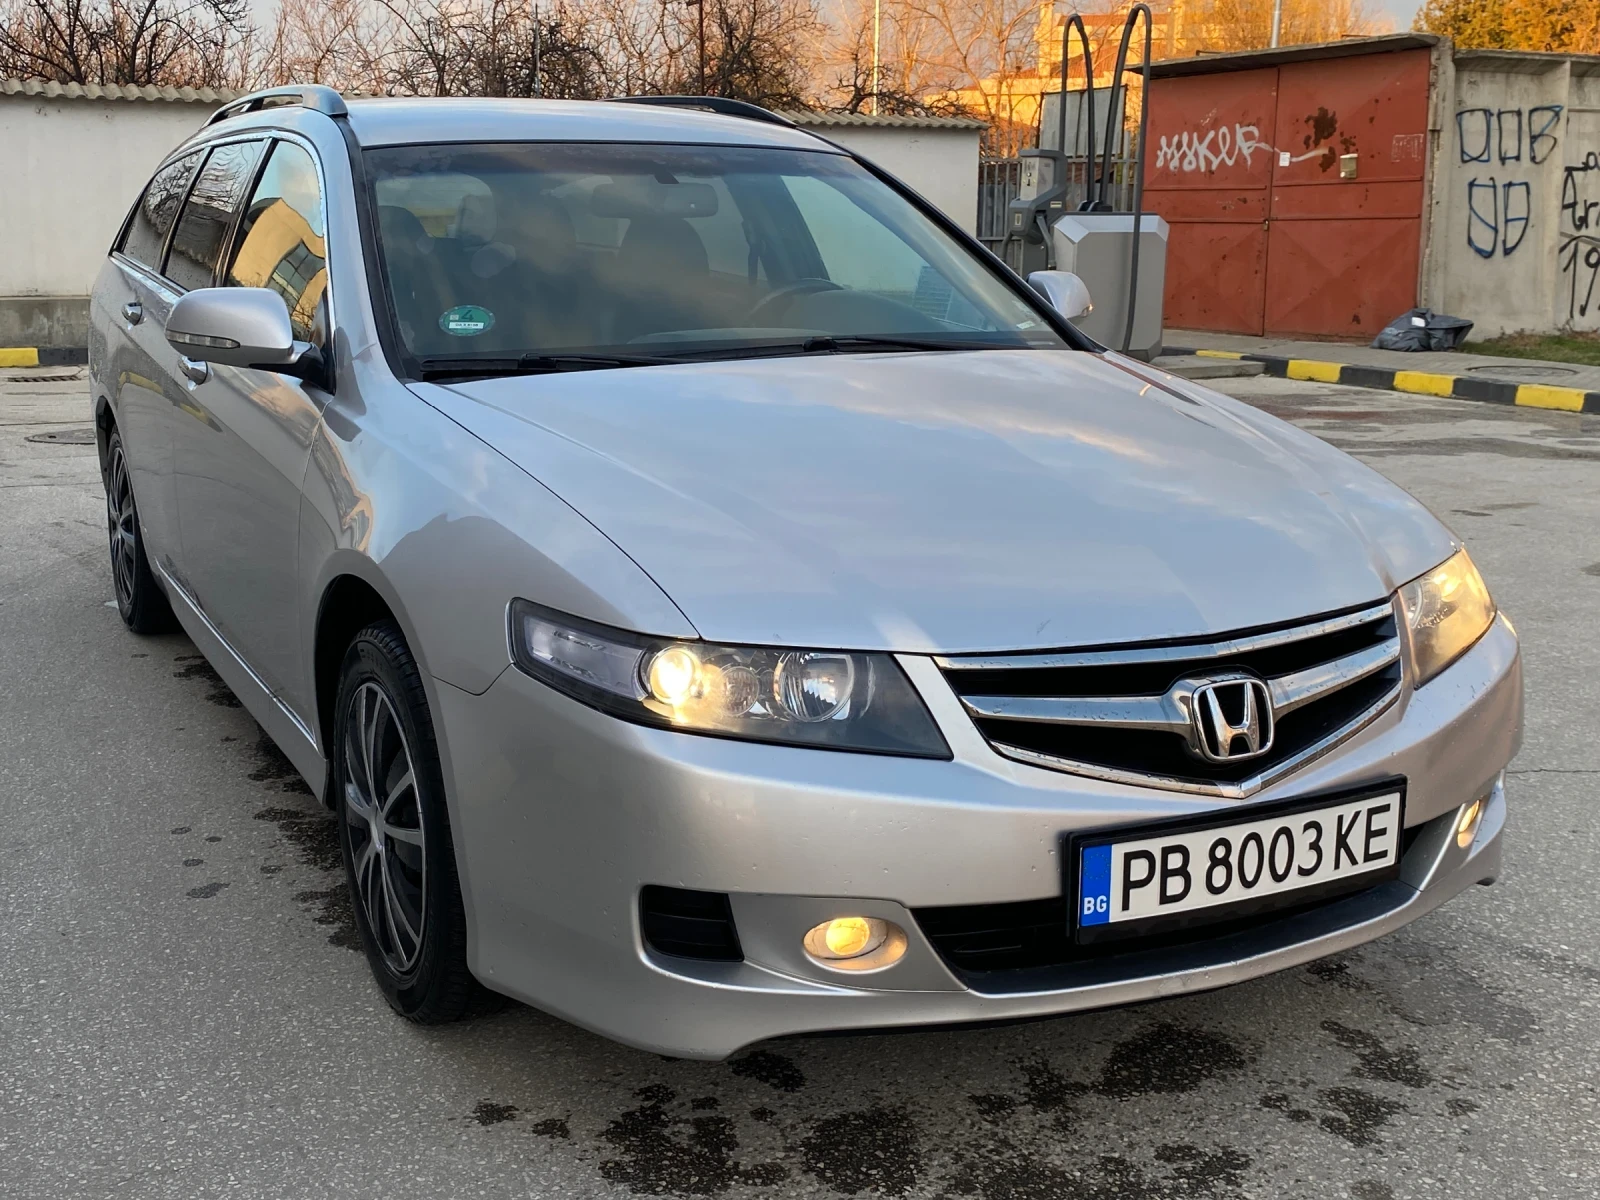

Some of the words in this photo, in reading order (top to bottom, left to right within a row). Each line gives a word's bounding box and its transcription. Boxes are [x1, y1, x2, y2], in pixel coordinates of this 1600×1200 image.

[461, 309, 475, 321] 4
[1121, 844, 1192, 912] PB
[1205, 820, 1323, 895] 8003
[1333, 803, 1391, 871] KE
[1083, 894, 1107, 915] BG
